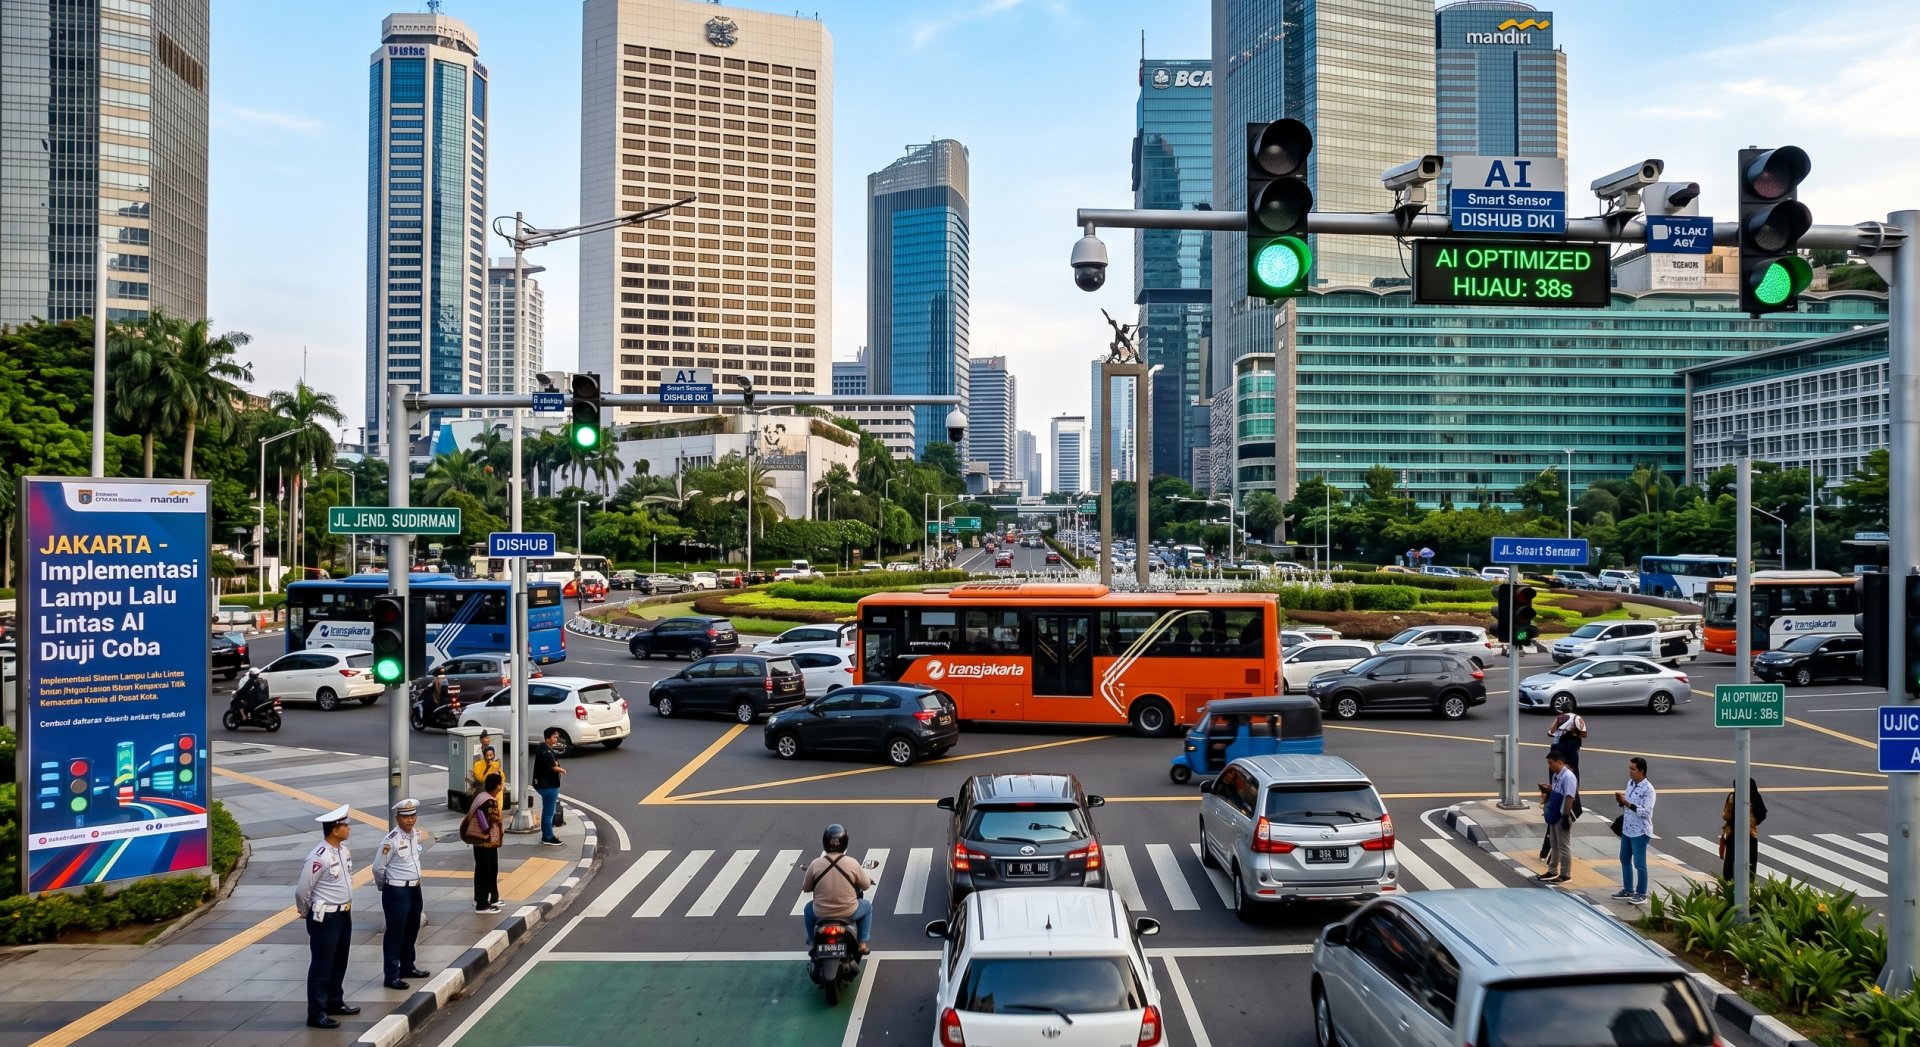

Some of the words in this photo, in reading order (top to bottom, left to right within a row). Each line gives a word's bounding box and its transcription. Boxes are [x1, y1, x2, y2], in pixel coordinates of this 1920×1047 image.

[1466, 28, 1531, 44] mandiri
[1174, 70, 1212, 87] BCA
[1484, 159, 1532, 188] AI
[1468, 193, 1505, 205] Smart
[1508, 194, 1552, 206] Sensor
[1461, 213, 1523, 227] DISHUB
[1527, 215, 1555, 228] DKI
[1435, 249, 1458, 268] AI
[1465, 250, 1591, 271] OPTIMIZED
[1454, 277, 1528, 298] HIJAU:
[1535, 279, 1573, 298] 38s
[675, 370, 696, 383] AI
[150, 495, 188, 503] mandiri
[353, 514, 388, 527] JEND.
[391, 514, 456, 528] SUDIRMAN
[40, 535, 152, 554] JAKARTA
[496, 538, 549, 551] DISHUB
[40, 559, 198, 584] Implementasi
[40, 588, 121, 610] Lampu
[129, 585, 177, 605] Lalu
[40, 614, 114, 634] Lintas
[121, 612, 144, 631] AI
[40, 640, 95, 664] Diuji
[102, 637, 161, 658] Coba
[948, 663, 1024, 679] transjakarta
[1721, 692, 1731, 703] AI
[1733, 691, 1778, 703] OPTIMIZED
